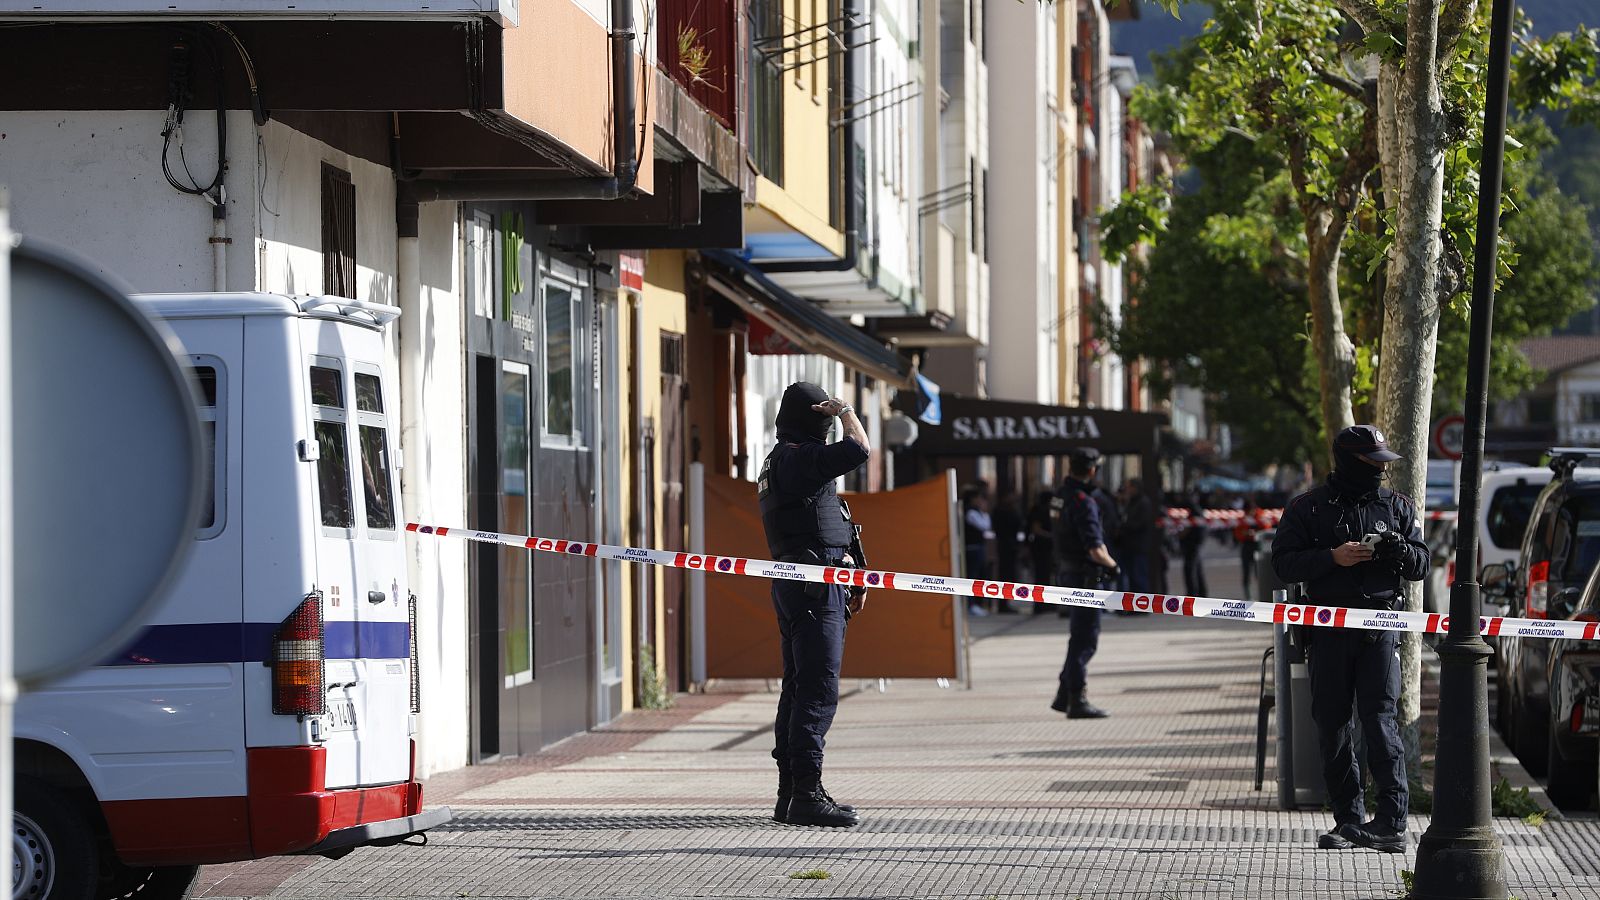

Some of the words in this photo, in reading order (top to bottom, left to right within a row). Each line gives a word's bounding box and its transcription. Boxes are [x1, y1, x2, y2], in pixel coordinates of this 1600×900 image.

[952, 415, 1101, 440] SARASUA
[625, 548, 648, 557] POLIZIA
[773, 563, 796, 571] POLIZIA
[922, 577, 945, 585] POLIZIA
[1071, 590, 1095, 598] POLIZIA
[1222, 601, 1246, 609] POLIZIA
[1375, 612, 1399, 620] POLIZIA
